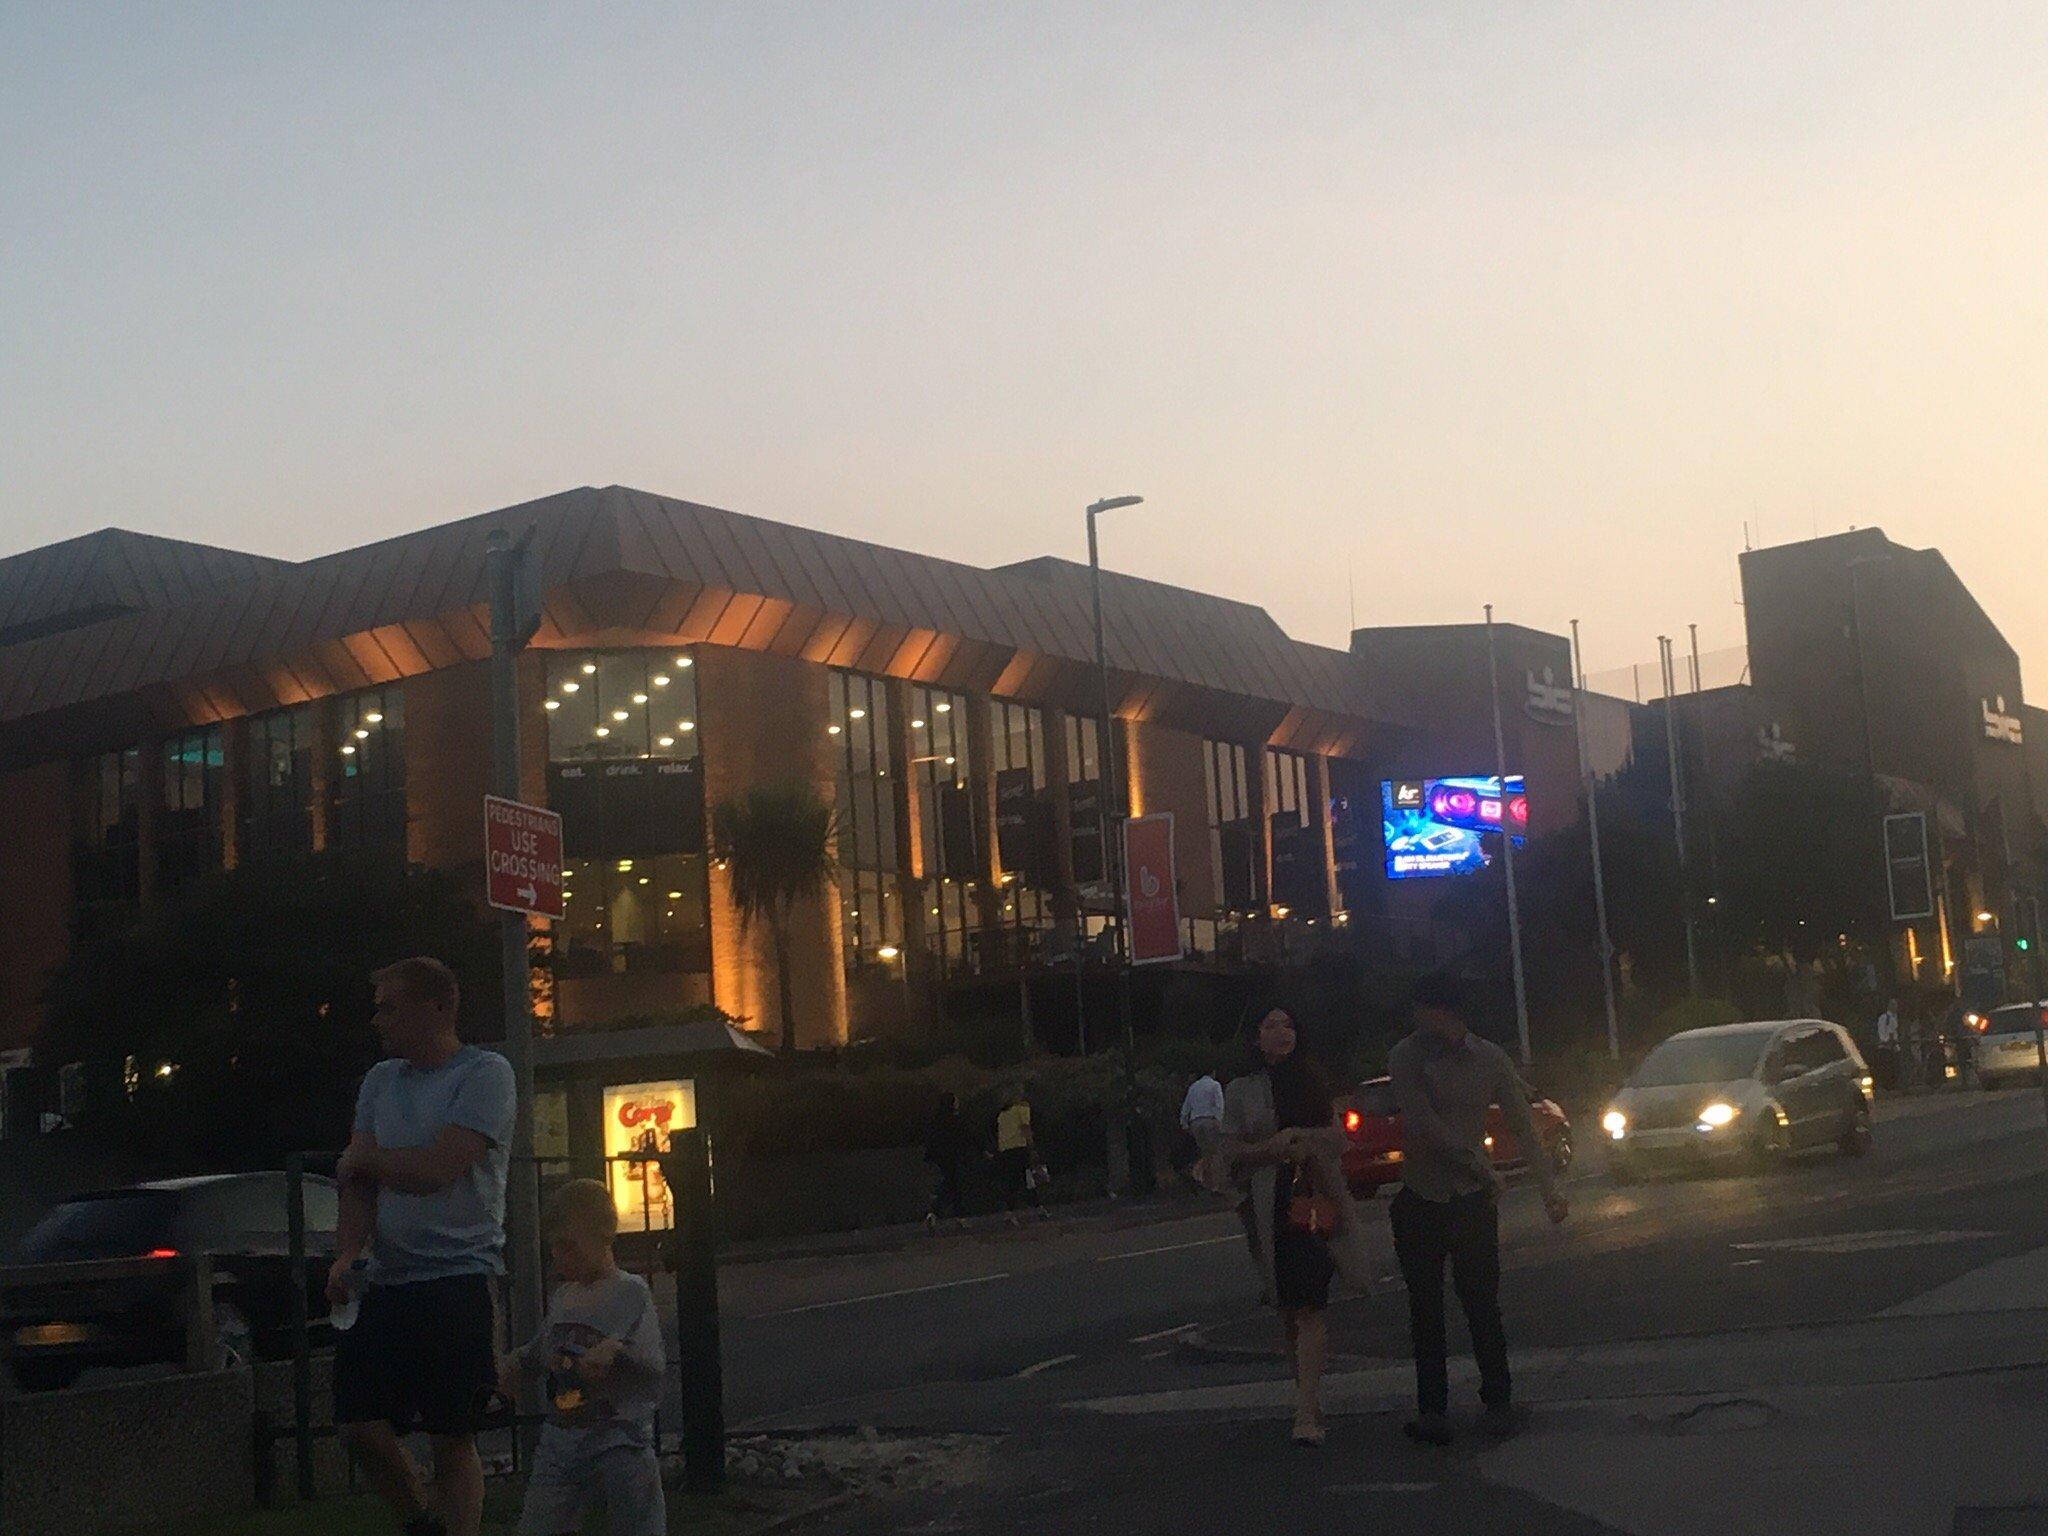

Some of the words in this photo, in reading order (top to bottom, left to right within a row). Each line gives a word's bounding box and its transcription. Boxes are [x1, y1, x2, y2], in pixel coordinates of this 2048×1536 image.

[489, 803, 558, 836] PEDESTRIANS
[511, 829, 538, 855] USE
[491, 849, 560, 886] CROSSING
